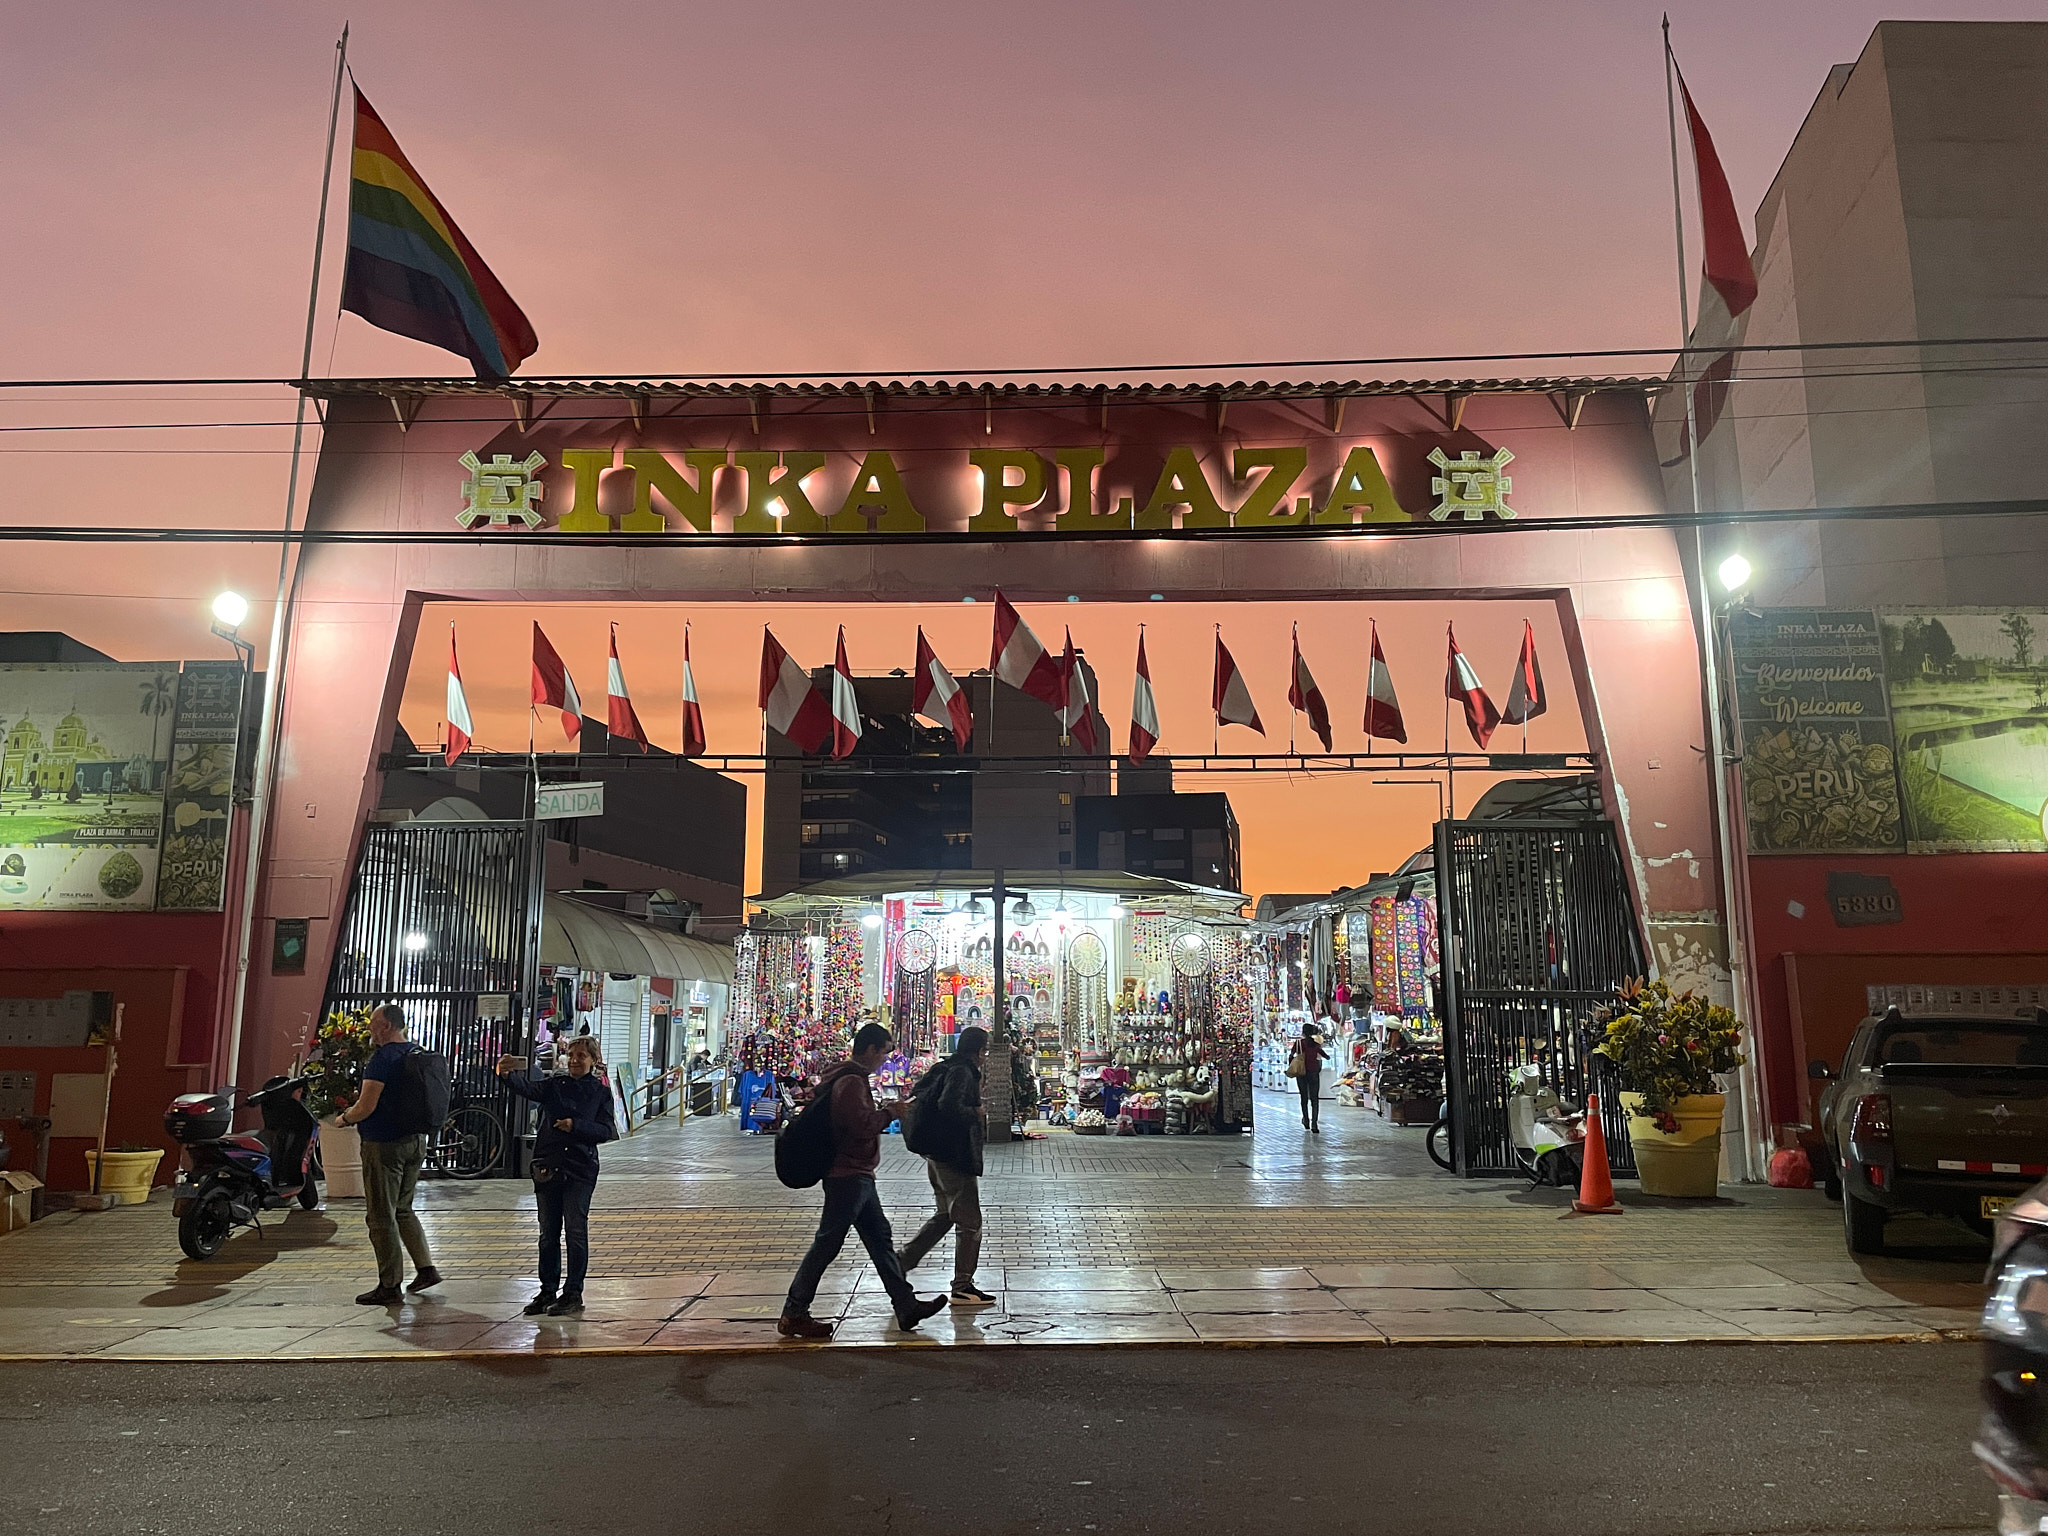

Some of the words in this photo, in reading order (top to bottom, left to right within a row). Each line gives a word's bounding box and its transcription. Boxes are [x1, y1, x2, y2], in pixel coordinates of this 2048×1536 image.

[559, 448, 926, 533] INKA
[969, 446, 1412, 531] PLAZA
[1777, 624, 1815, 634] INKA
[1819, 623, 1867, 634] PLAZA
[1741, 662, 1876, 694] Bienvenidos
[206, 712, 235, 720] PLAZA
[1760, 696, 1865, 723] Welcome
[1774, 768, 1855, 803] PERU
[538, 792, 601, 815] SALIDA
[80, 828, 97, 837] PLAZA
[97, 828, 105, 837] DE
[105, 828, 126, 837] ARMAS
[171, 860, 217, 880] PERU
